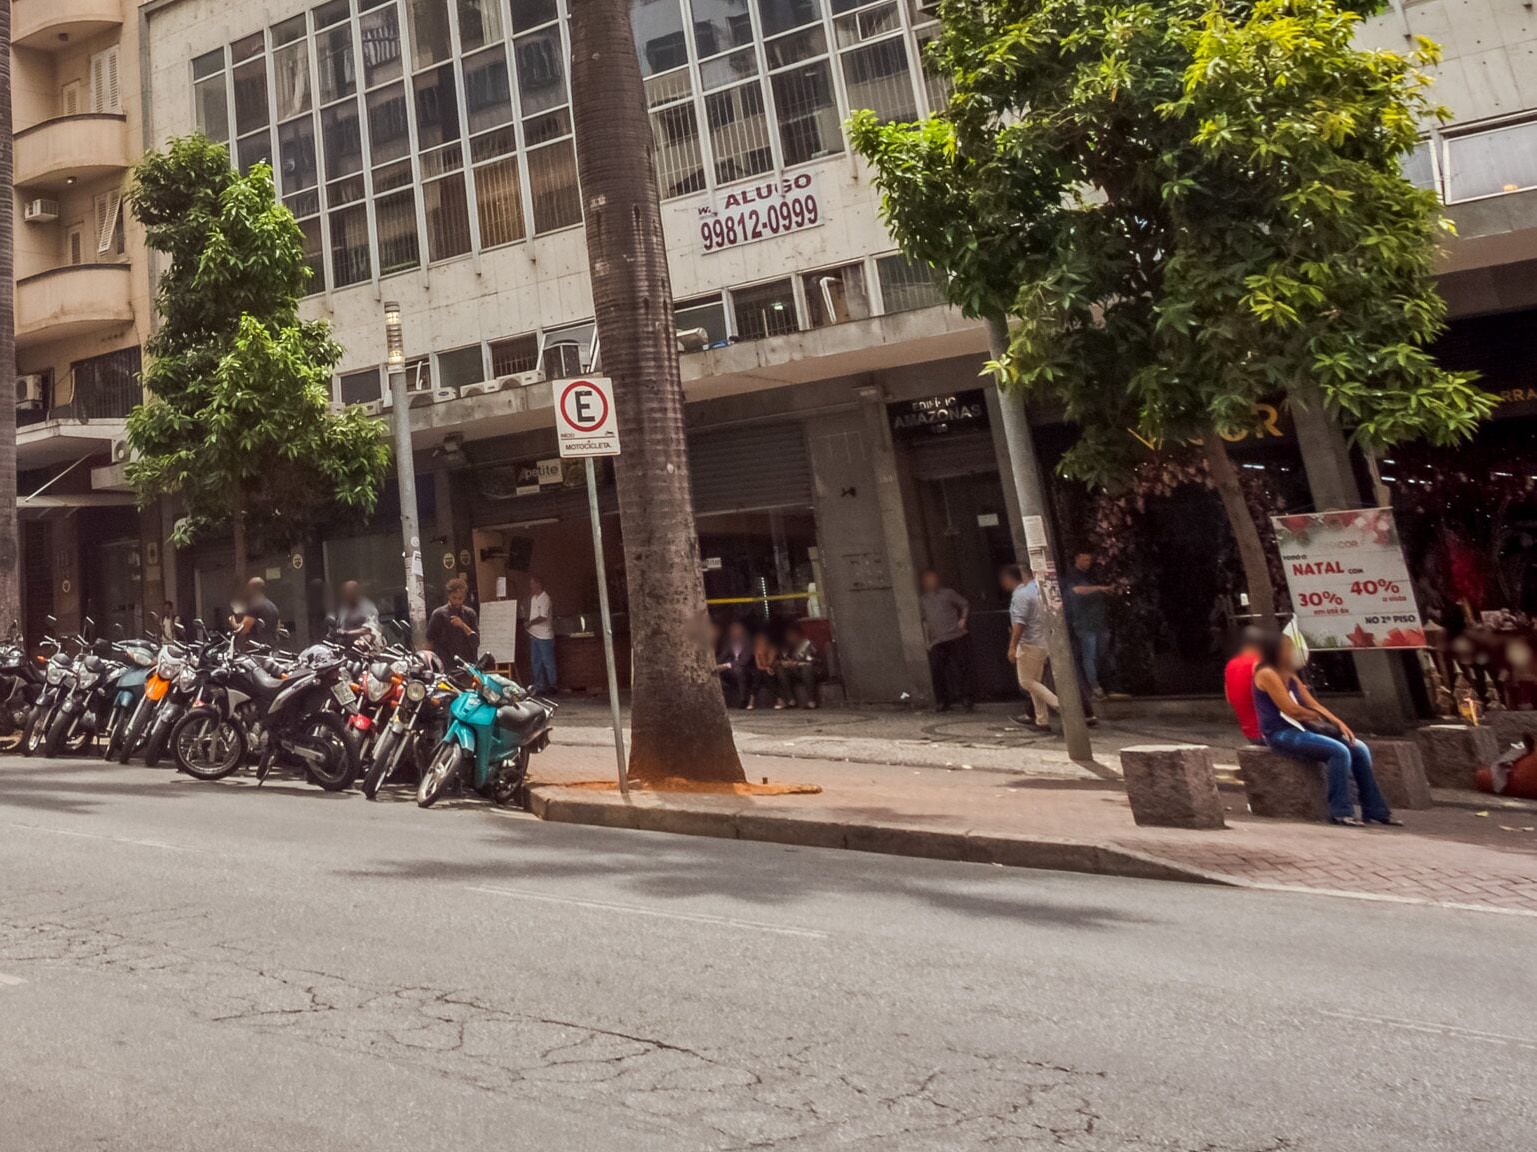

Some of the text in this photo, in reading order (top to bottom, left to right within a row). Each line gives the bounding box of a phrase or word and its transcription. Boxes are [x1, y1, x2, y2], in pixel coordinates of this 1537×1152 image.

[701, 194, 819, 251] 99812-0999
[574, 390, 596, 423] E
[894, 404, 982, 428] AMAZONAS
[1292, 561, 1344, 576] NATAL
[1350, 578, 1400, 596] 40%
[1298, 591, 1343, 607] 30%
[1365, 616, 1379, 624] NO
[1393, 614, 1416, 623] PISO
